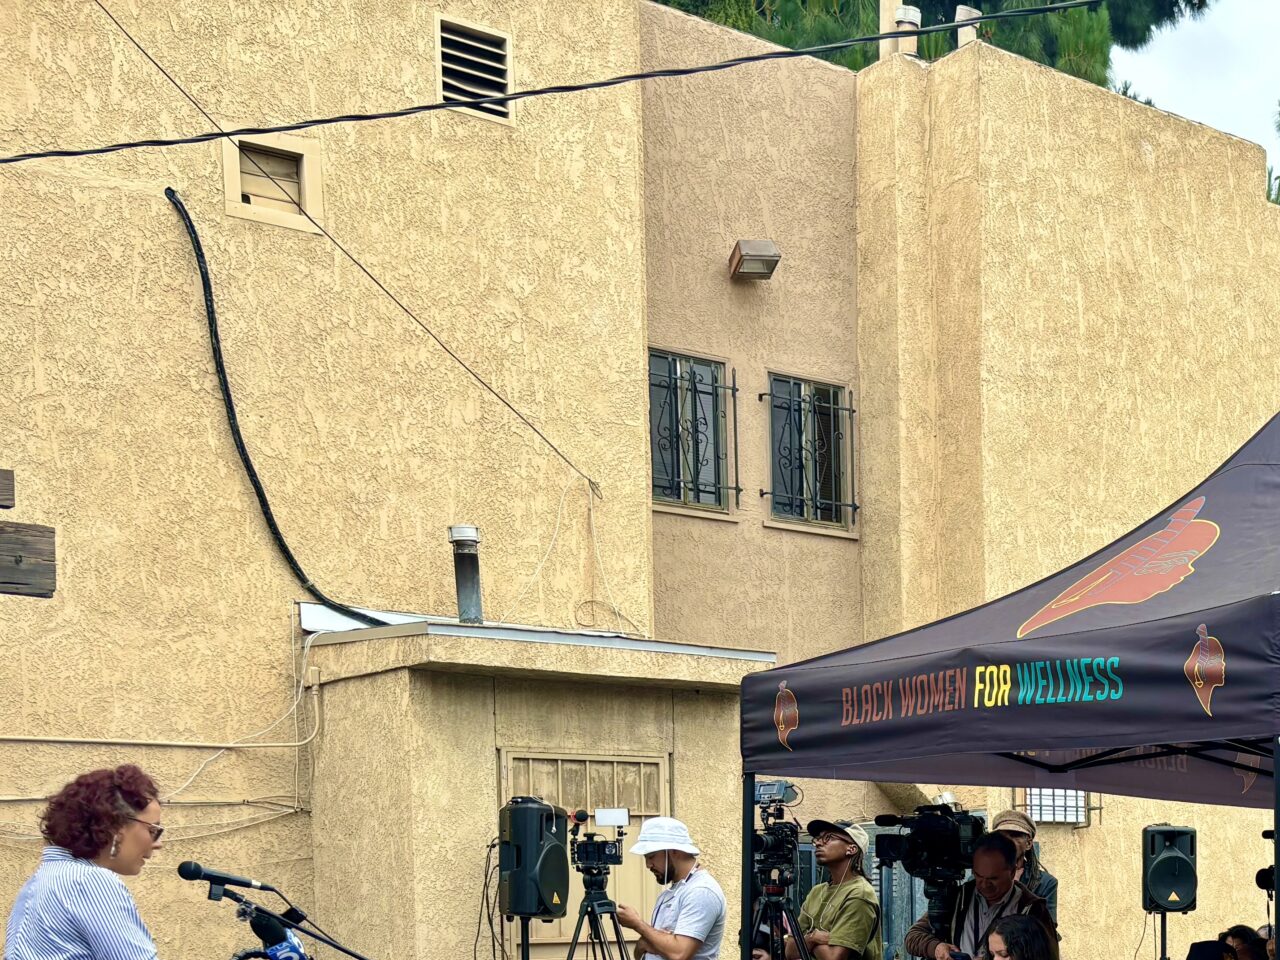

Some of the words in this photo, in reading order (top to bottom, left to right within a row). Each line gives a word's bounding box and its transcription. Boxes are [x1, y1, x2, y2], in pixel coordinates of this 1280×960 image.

[841, 680, 893, 726] BLACK
[899, 667, 967, 718] WOMEN
[974, 664, 1012, 708] FOR
[1016, 657, 1124, 704] WELLNESS
